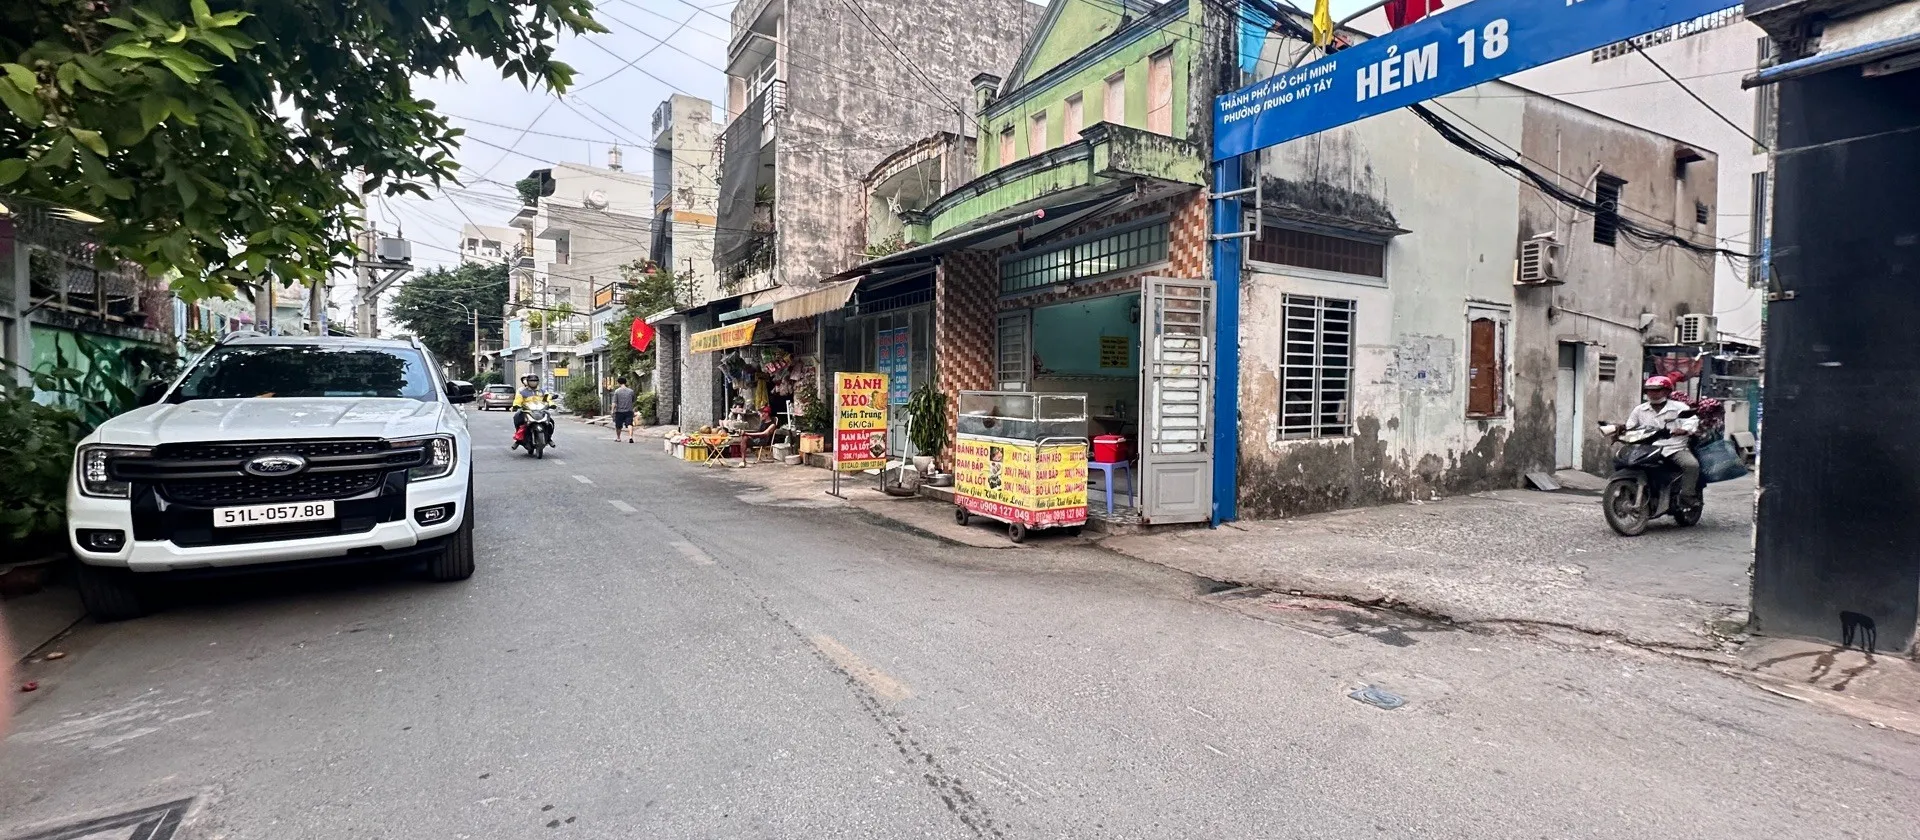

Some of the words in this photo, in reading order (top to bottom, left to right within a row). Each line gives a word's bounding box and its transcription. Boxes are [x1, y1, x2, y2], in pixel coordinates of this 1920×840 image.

[1356, 46, 1439, 103] HẺM
[1457, 18, 1509, 68] 18
[1221, 93, 1249, 111] THÀNH
[1251, 81, 1271, 101] PHỐ
[1272, 76, 1287, 93] HỒ
[1289, 68, 1308, 86] CHÍ
[1310, 60, 1337, 79] MINH
[1223, 103, 1261, 124] PHƯỜNG
[1263, 93, 1294, 111] TRUNG
[1297, 84, 1312, 99] MỸ
[1314, 78, 1333, 93] TÂY
[843, 376, 882, 390] BÁNH
[841, 391, 867, 407] XÈO
[860, 410, 882, 421] Trung
[848, 420, 875, 429] 6K/Cái
[841, 433, 856, 441] RAM
[841, 442, 849, 451] BÒ
[850, 442, 858, 451] LÁ
[957, 443, 975, 455] BÁNH
[976, 445, 989, 457] XÈO
[956, 459, 970, 469] RAM
[956, 471, 965, 483] BÒ
[966, 473, 974, 485] LÁ
[975, 473, 987, 487] LỐT
[224, 504, 325, 523] 51L-057.88
[980, 500, 998, 513] 0909
[1000, 505, 1013, 516] 127
[1015, 508, 1030, 521] 049
